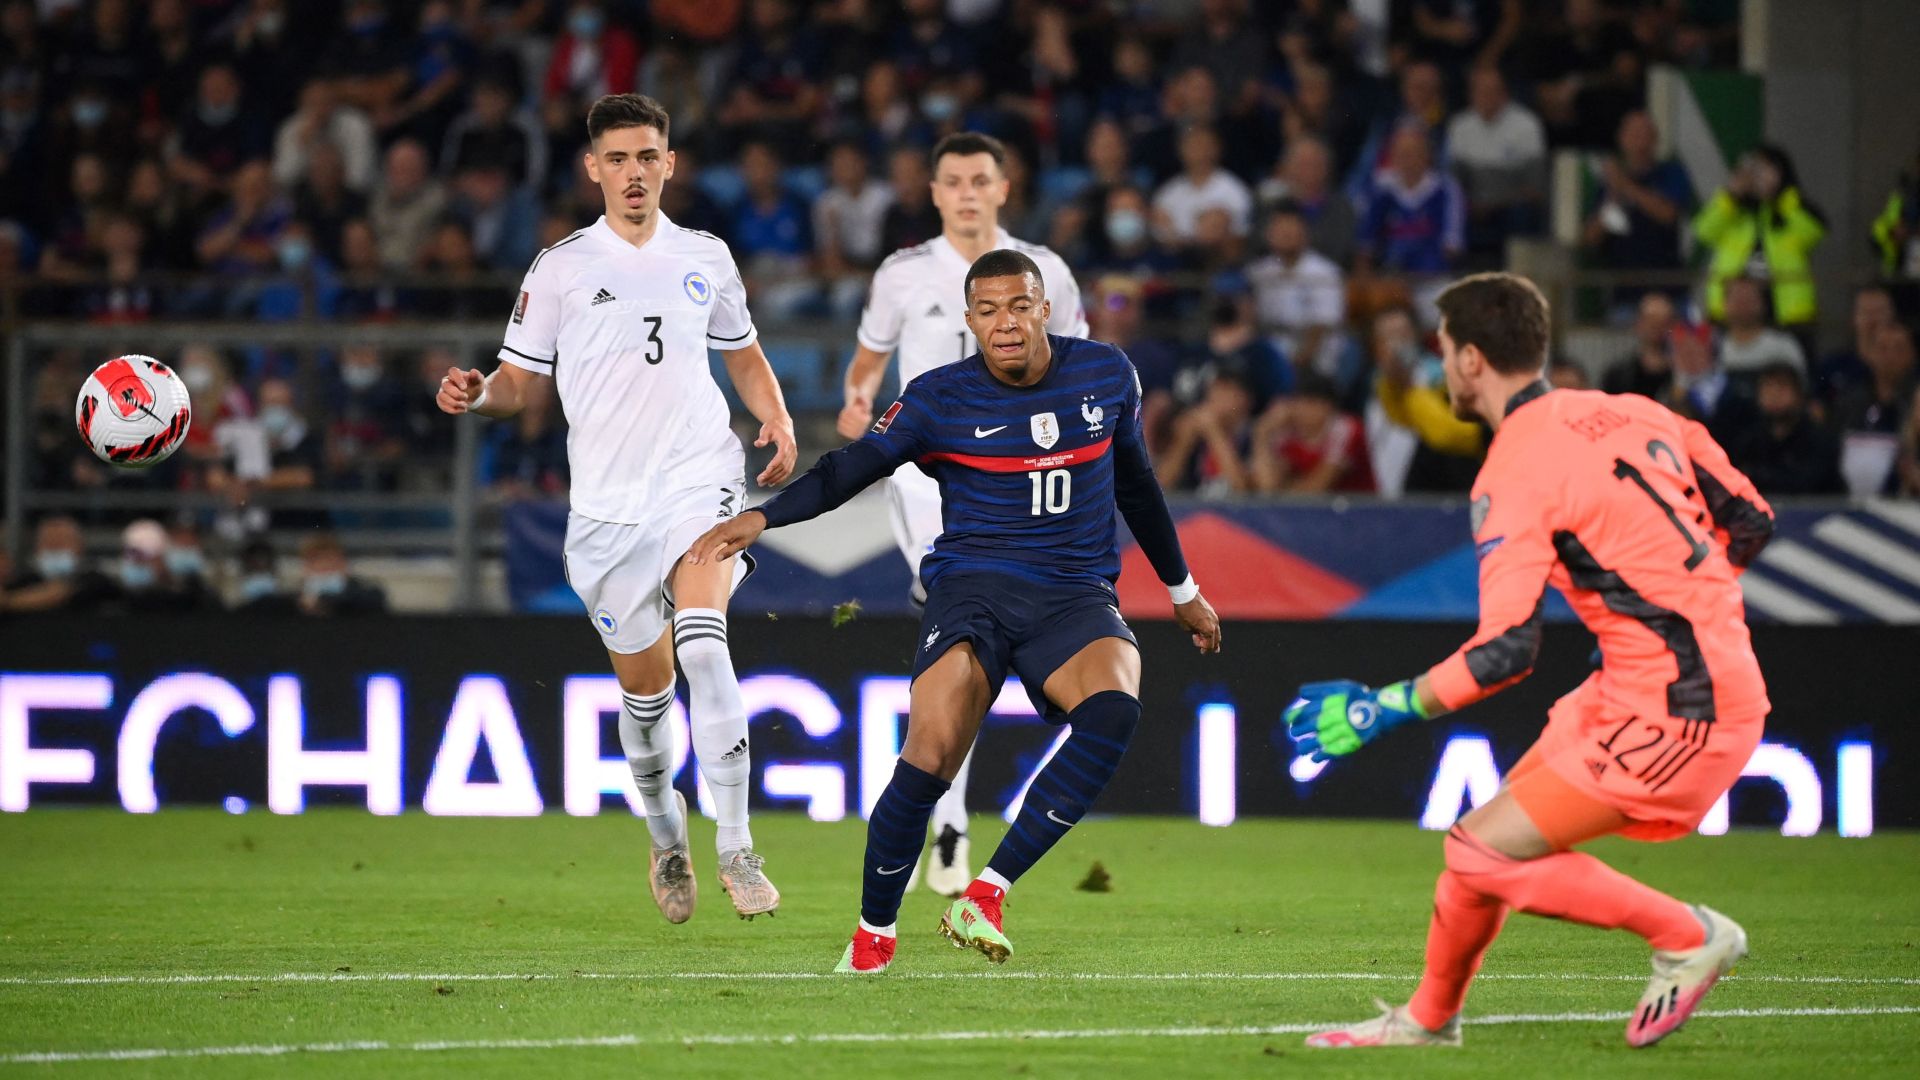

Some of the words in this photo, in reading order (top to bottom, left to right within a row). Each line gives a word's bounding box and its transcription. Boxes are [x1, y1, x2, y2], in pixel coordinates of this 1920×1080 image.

[643, 316, 664, 365] 3
[1029, 469, 1071, 515] 10
[1598, 715, 1665, 772] 12
